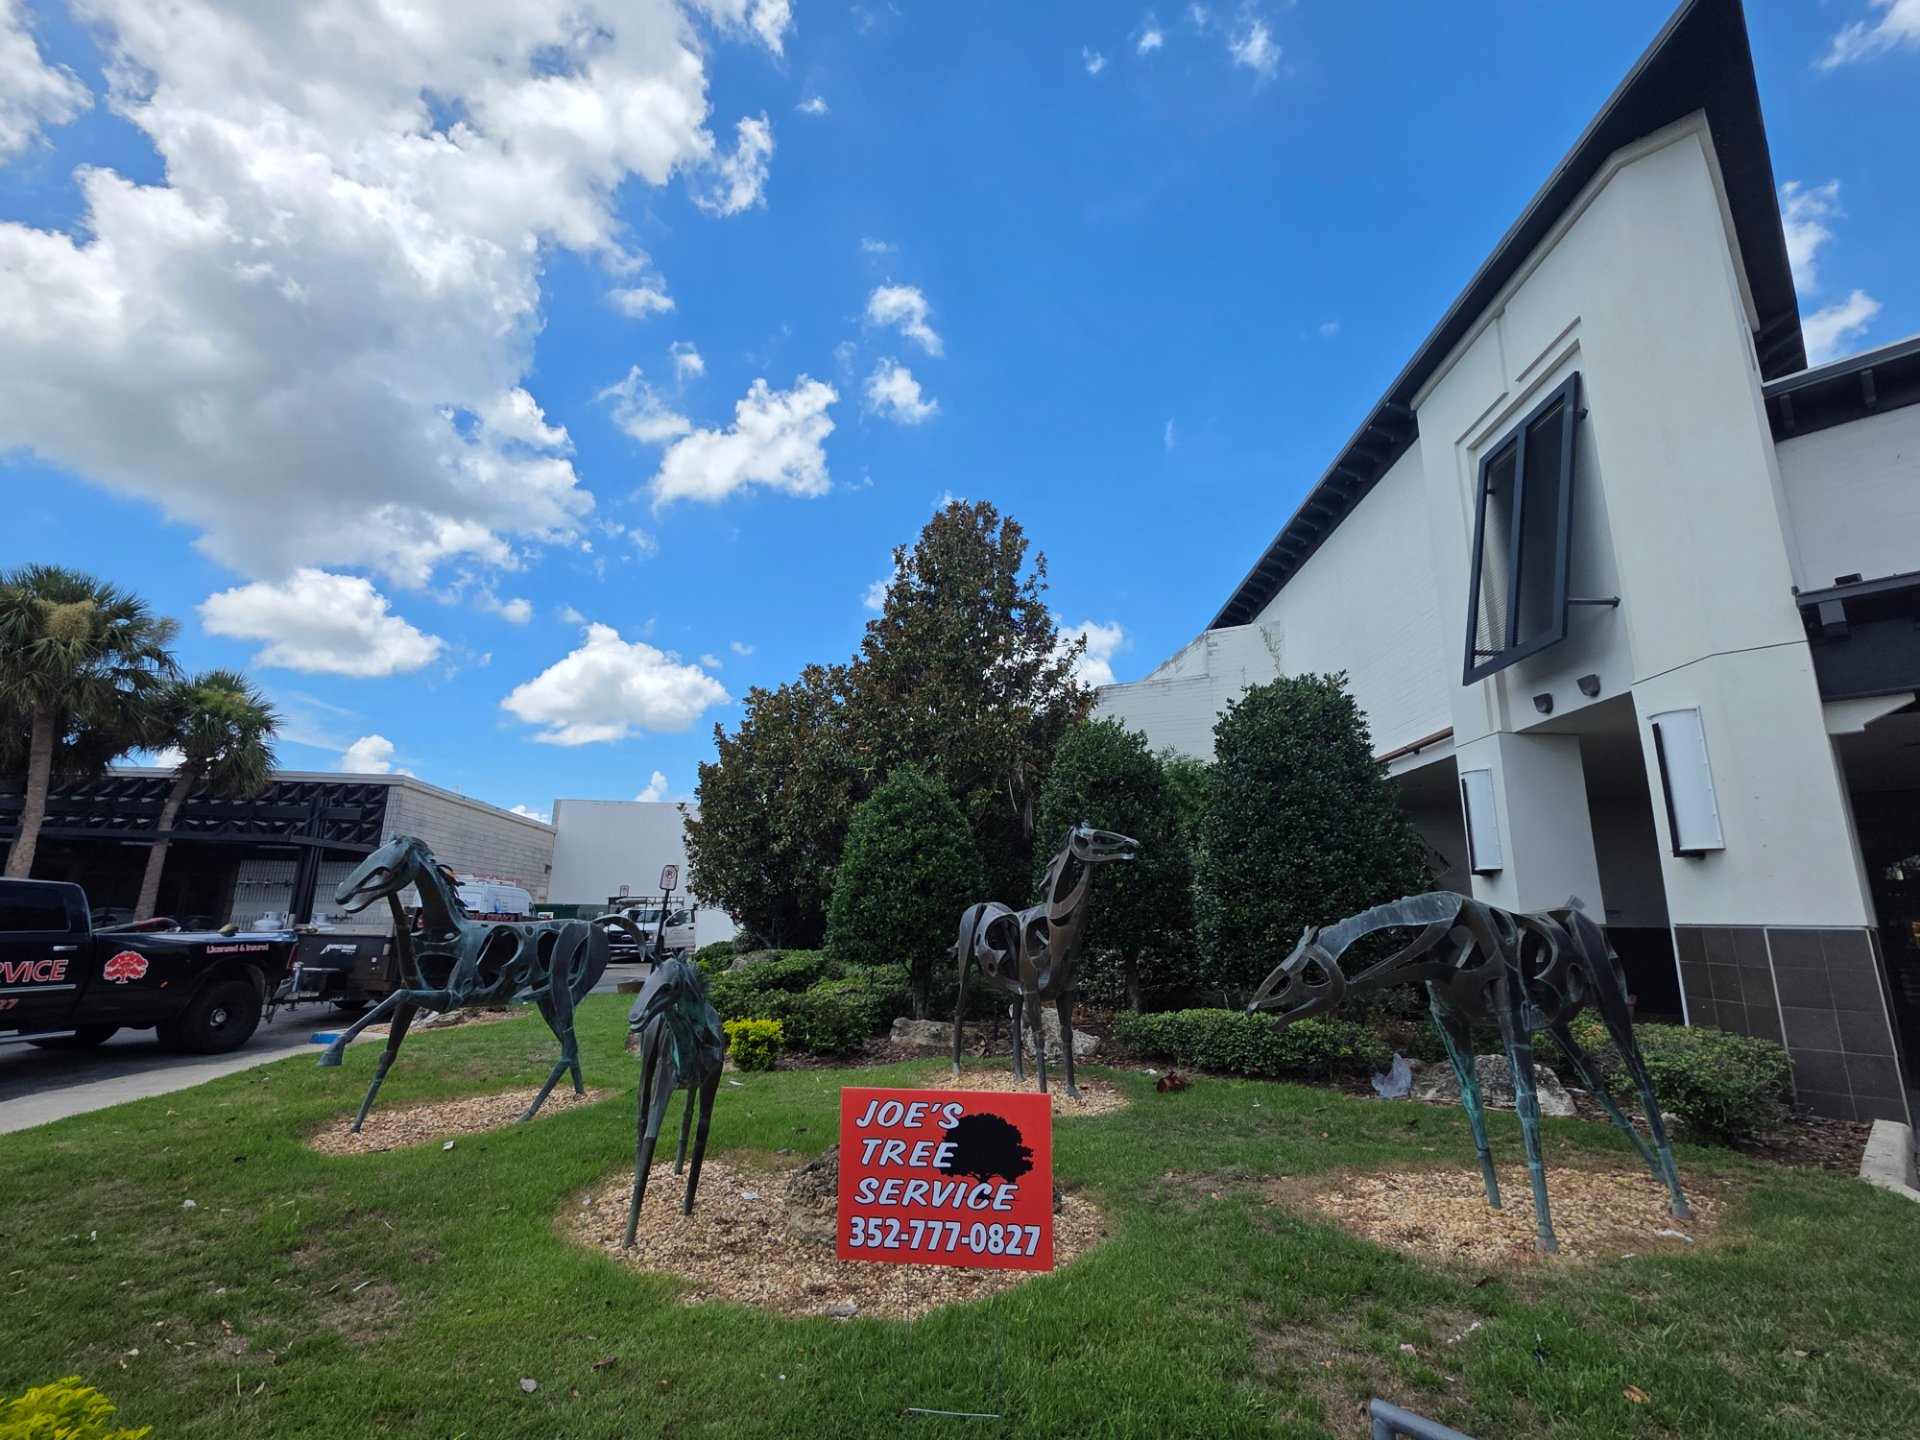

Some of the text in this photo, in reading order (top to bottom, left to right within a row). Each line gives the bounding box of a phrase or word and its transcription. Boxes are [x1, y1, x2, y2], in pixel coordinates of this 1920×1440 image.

[855, 1099, 964, 1129] JOE'S
[860, 1138, 959, 1168] TREE
[854, 1176, 1019, 1211] SERVICE
[848, 1216, 1041, 1257] 352-777-0827
